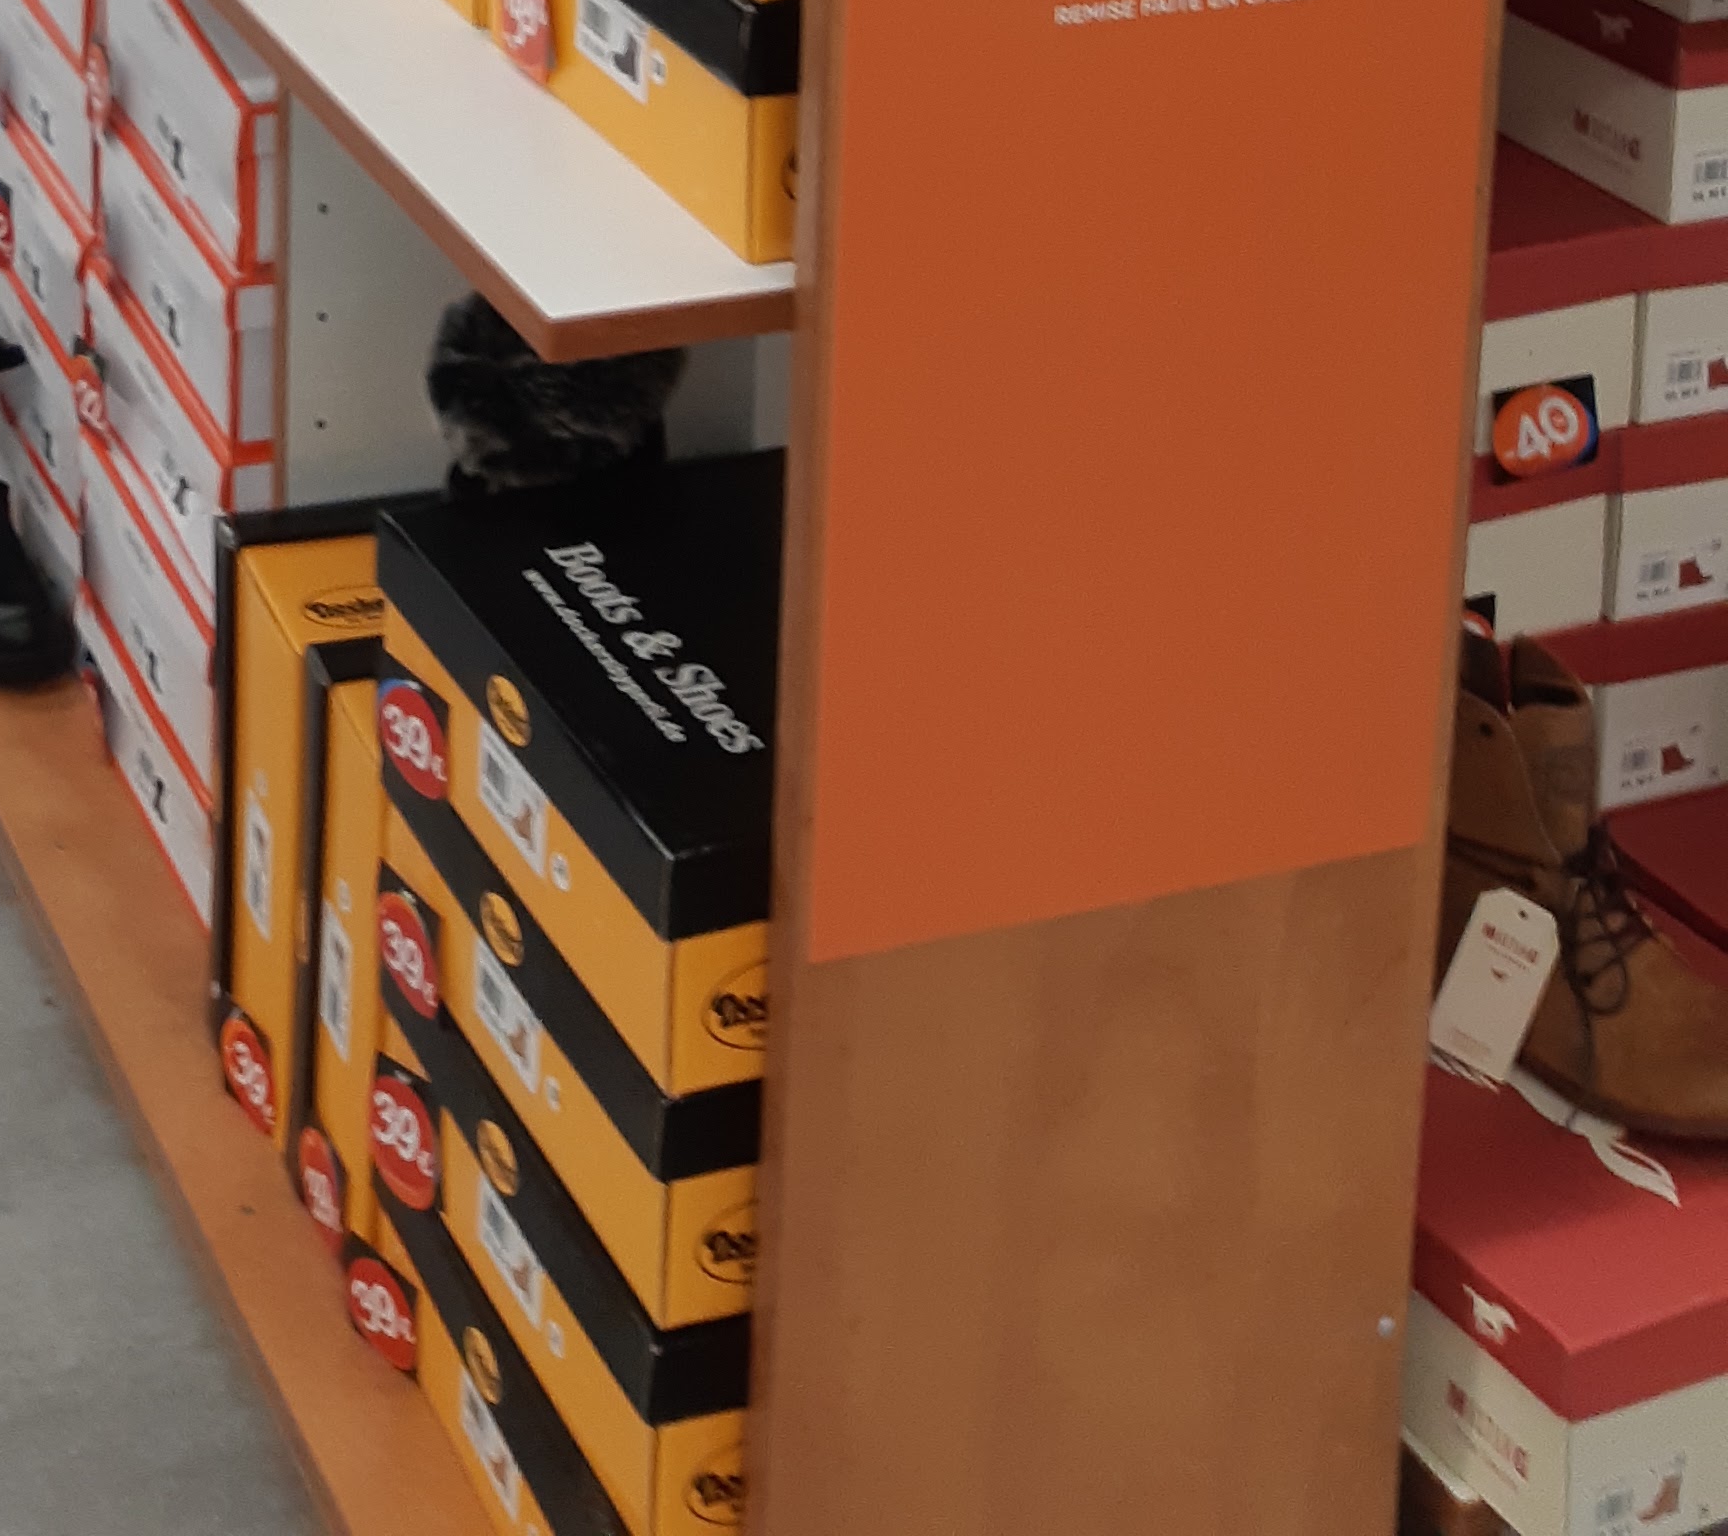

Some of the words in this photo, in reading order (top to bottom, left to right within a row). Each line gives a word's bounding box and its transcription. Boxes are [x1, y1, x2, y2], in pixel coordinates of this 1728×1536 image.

[542, 541, 643, 624] Boots
[621, 630, 683, 661] &
[653, 663, 766, 754] Shoes
